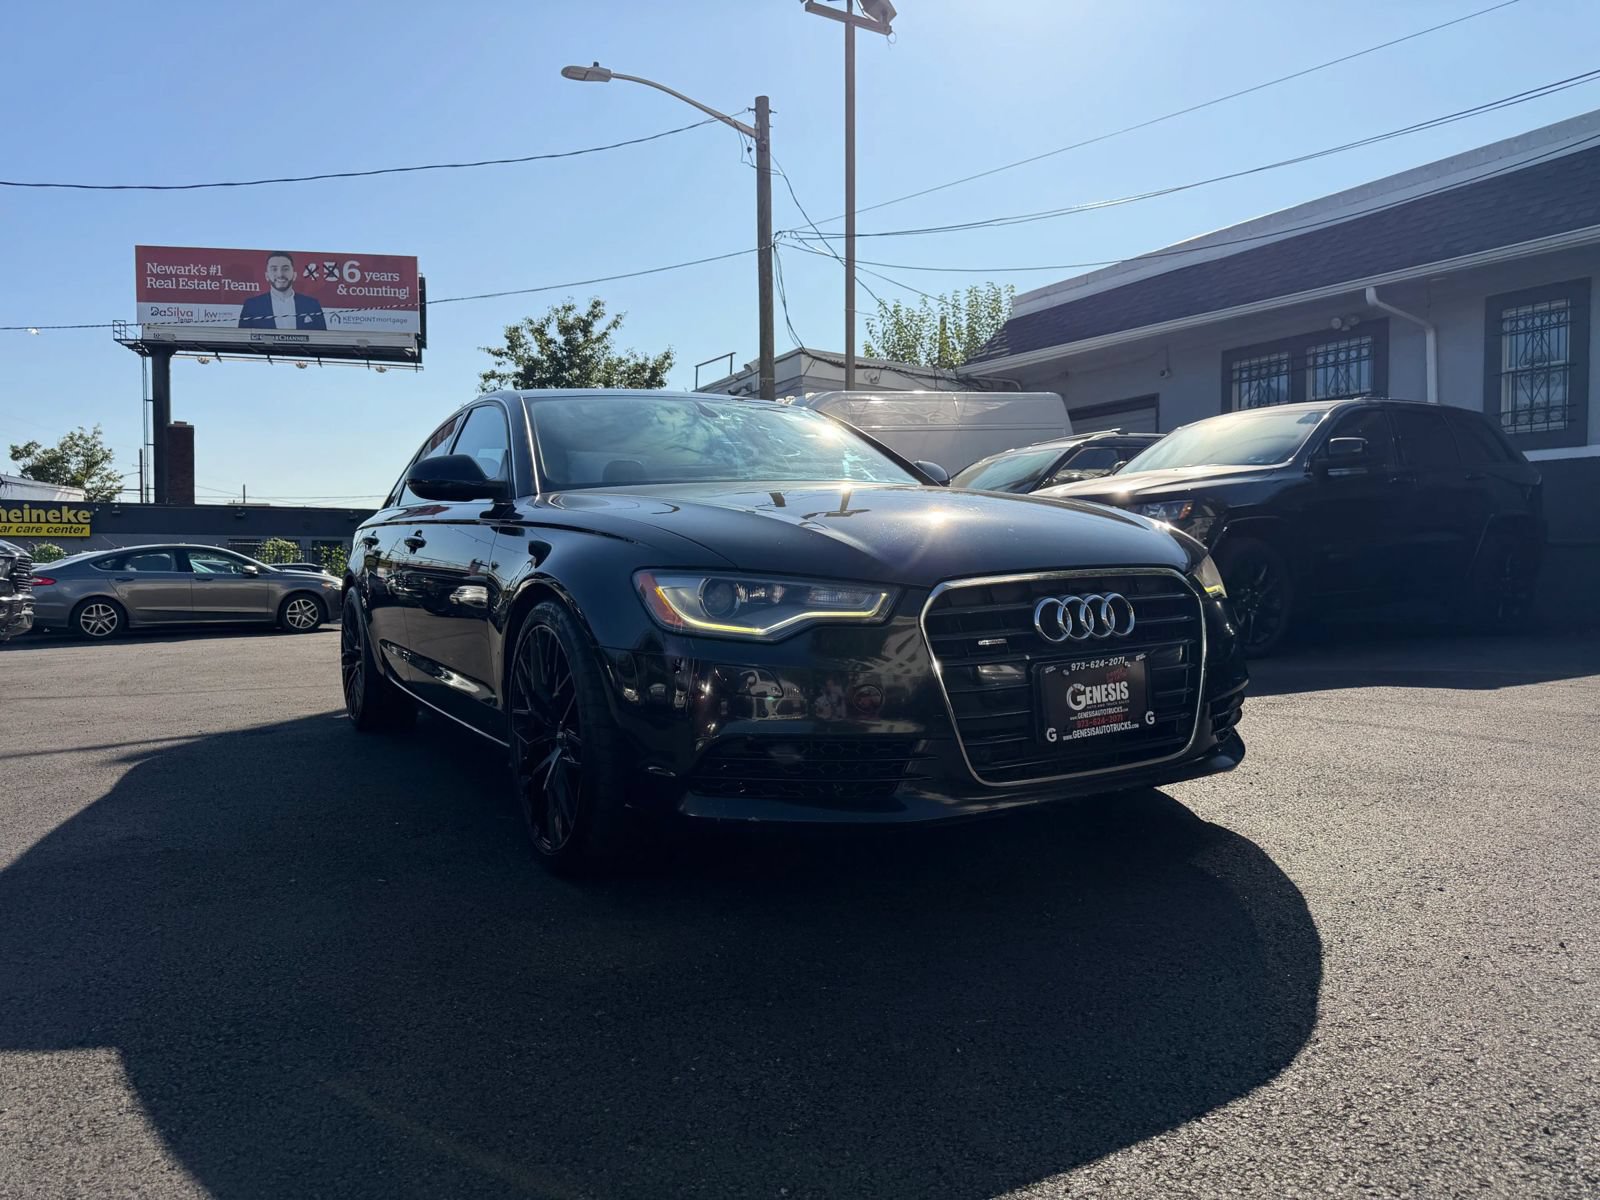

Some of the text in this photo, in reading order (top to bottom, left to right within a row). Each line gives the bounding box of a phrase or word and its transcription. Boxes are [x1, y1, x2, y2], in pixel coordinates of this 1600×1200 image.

[146, 262, 223, 276] Newark's #1
[342, 260, 361, 283] 6
[364, 271, 400, 283] years
[146, 277, 260, 292] Real Estate Team
[336, 284, 410, 299] & counting!
[150, 306, 194, 317] DaSilva
[204, 309, 218, 318] kw
[16, 525, 43, 534] care
[46, 524, 86, 534] center
[1071, 656, 1125, 671] 973-624-2071
[1066, 681, 1130, 710] GENESIS
[1145, 711, 1156, 725] G
[1046, 727, 1057, 742] G
